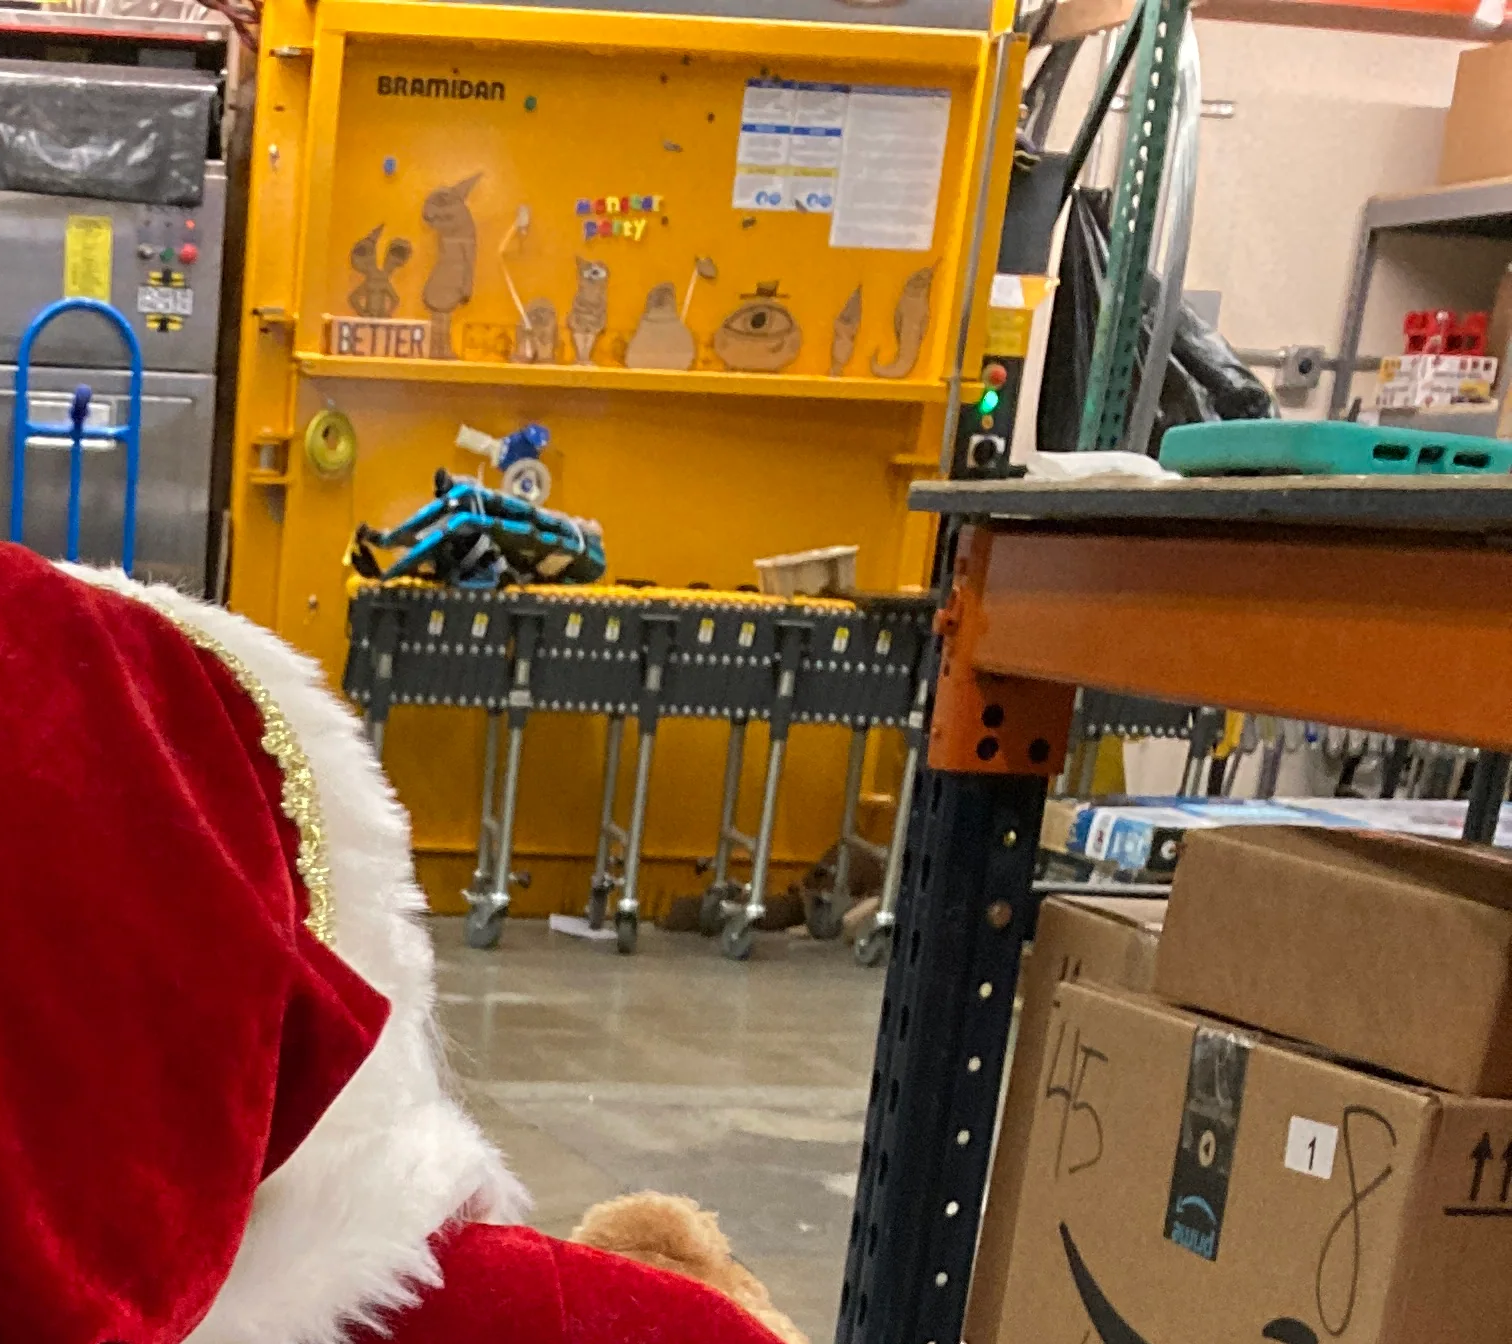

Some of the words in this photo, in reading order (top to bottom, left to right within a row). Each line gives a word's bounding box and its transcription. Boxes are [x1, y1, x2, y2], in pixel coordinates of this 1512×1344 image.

[377, 75, 506, 101] BRAMIDAN
[338, 322, 425, 358] BETTER
[1306, 1135, 1317, 1172] 1
